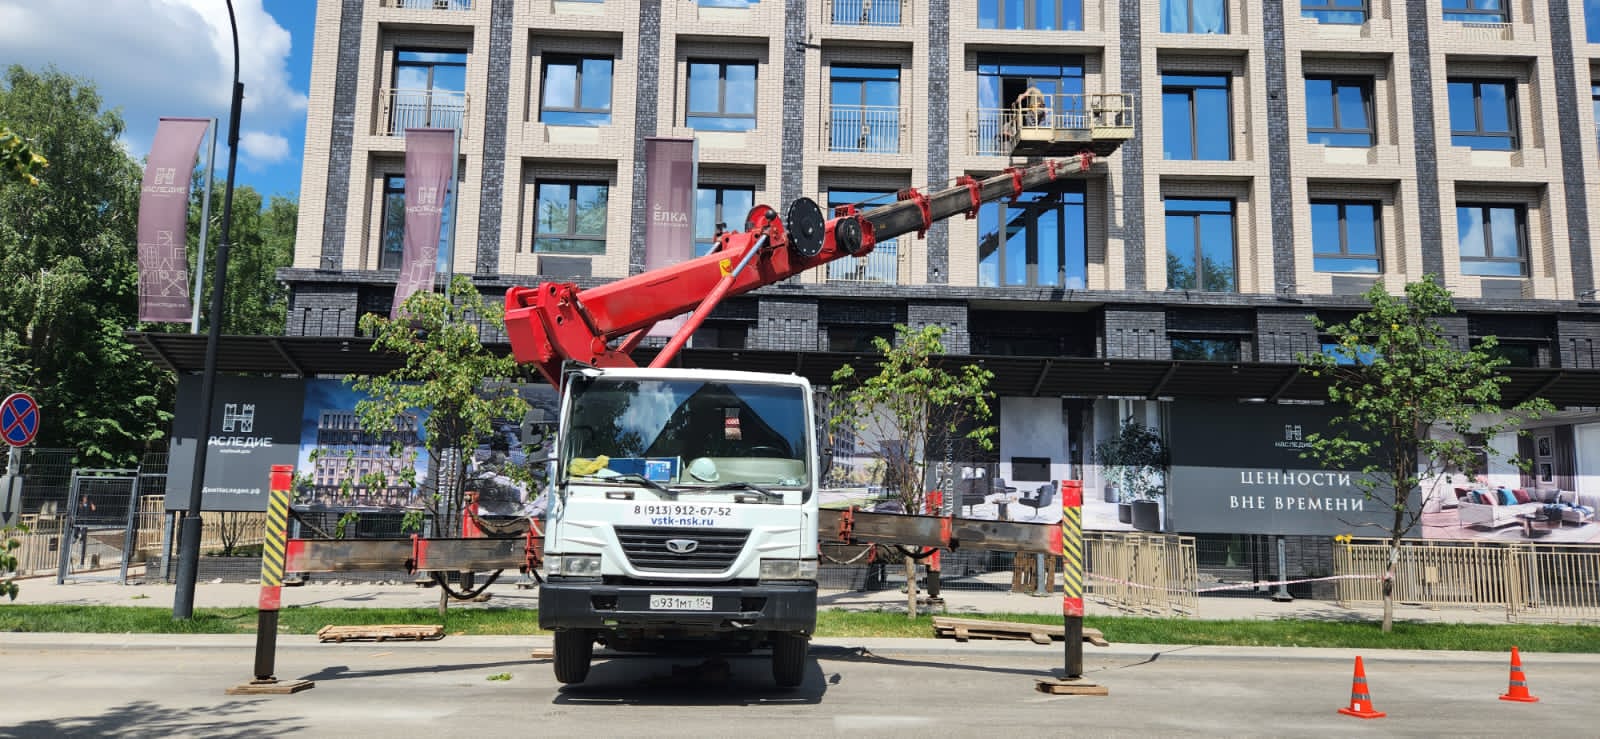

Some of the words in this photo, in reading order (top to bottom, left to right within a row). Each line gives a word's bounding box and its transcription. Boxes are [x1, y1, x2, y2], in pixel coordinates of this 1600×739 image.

[208, 436, 273, 448] АСЛЕДИЕ
[1240, 471, 1350, 486] ЦЕННОСТИ
[1230, 495, 1265, 509] ВНЕ
[1275, 496, 1363, 511] ВРЕМЕНИ
[634, 505, 641, 514] 8
[644, 505, 672, 516] (913)
[675, 506, 732, 516] 912-67-52
[651, 517, 714, 526] vstk-nsk.ru
